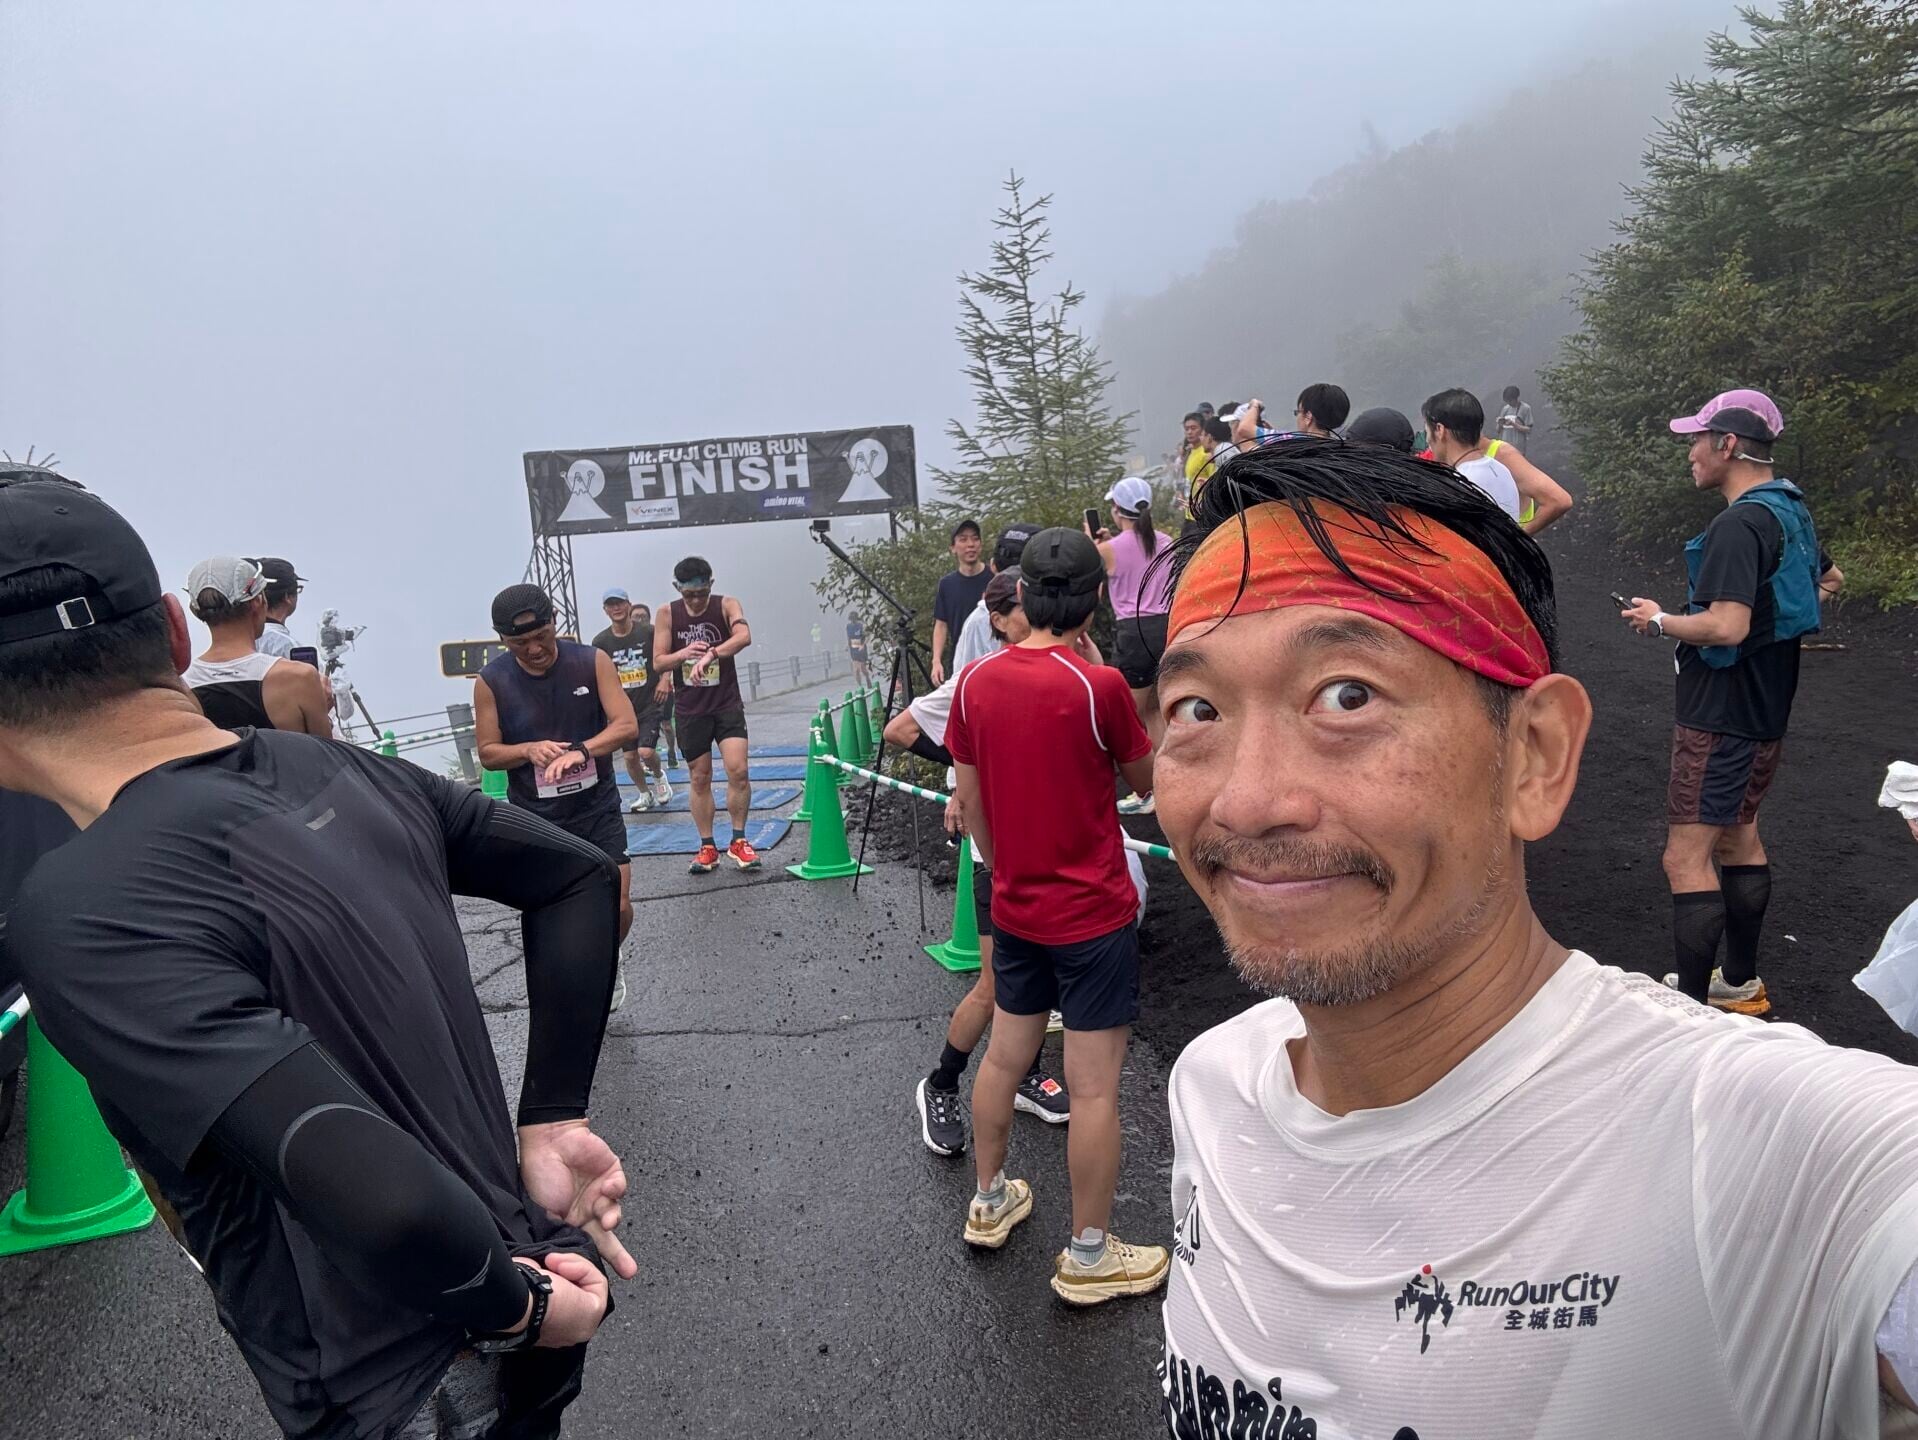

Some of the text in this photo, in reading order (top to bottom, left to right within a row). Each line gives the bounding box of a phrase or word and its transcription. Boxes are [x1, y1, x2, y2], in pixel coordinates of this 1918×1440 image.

[628, 437, 808, 466] Mt.FUJI CLIMB RUN
[628, 454, 811, 500] FINISH
[689, 623, 706, 632] THE
[1457, 1271, 1620, 1307] RunOurCity
[1503, 1304, 1599, 1330] 全城街馬
